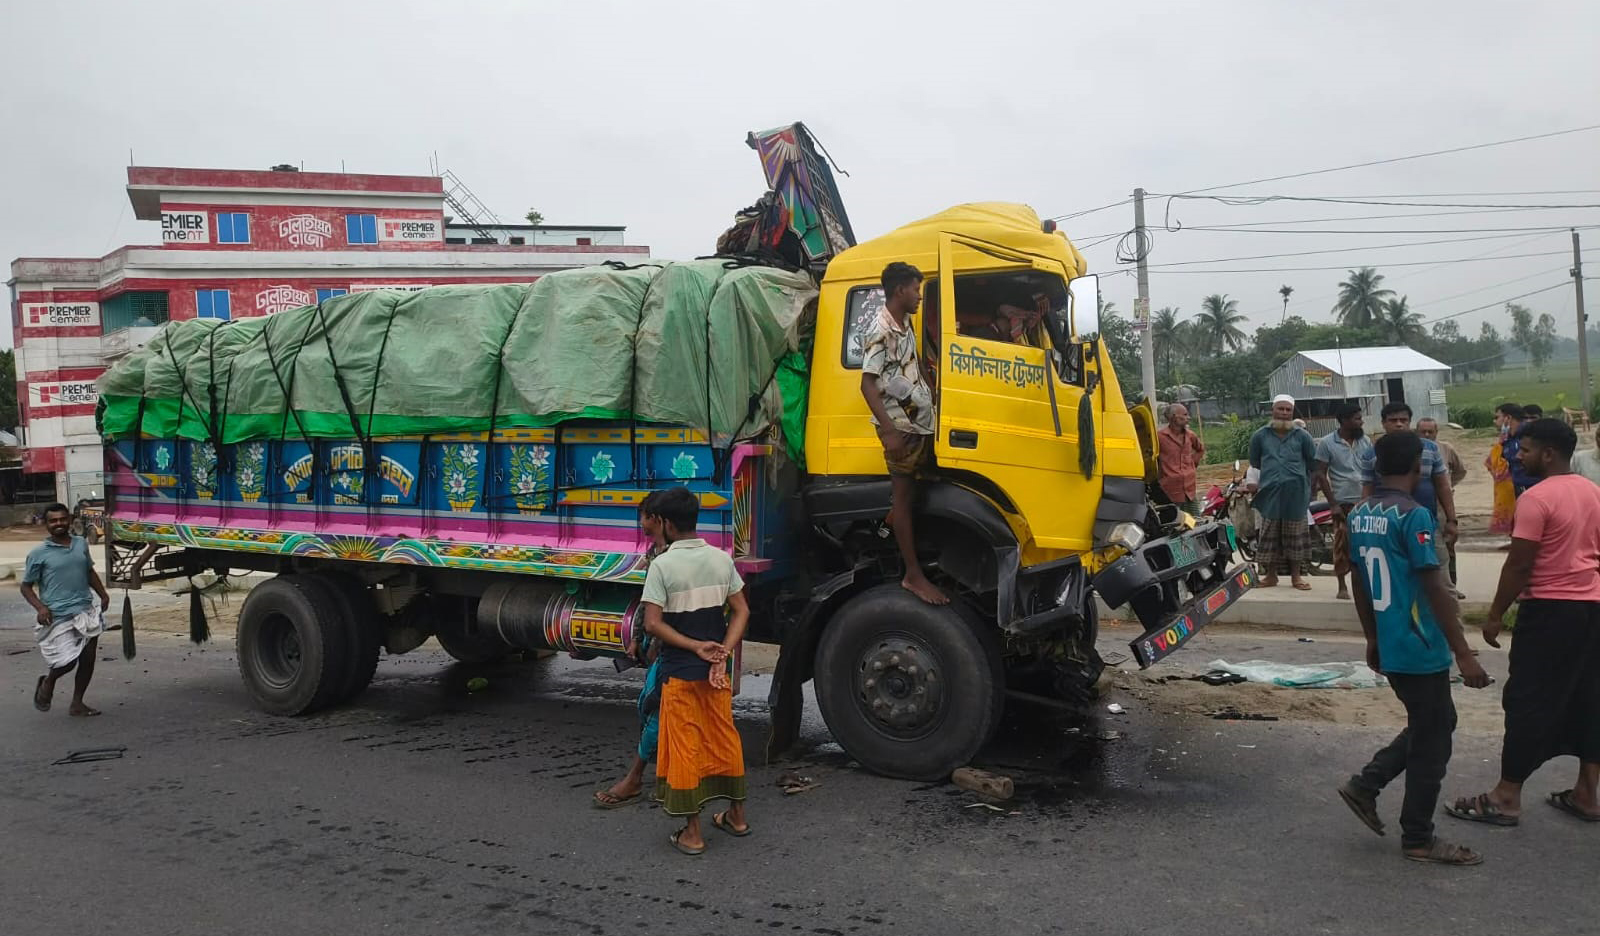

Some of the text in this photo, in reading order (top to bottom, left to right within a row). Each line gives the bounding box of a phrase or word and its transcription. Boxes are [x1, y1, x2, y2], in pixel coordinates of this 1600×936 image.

[401, 222, 435, 232] PREMIER
[288, 233, 324, 248] রাজা
[49, 306, 91, 316] PREMIER
[62, 384, 97, 395] PREMIE
[64, 394, 97, 402] emen
[571, 619, 621, 643] FUEL
[1153, 615, 1194, 651] VOLVO
